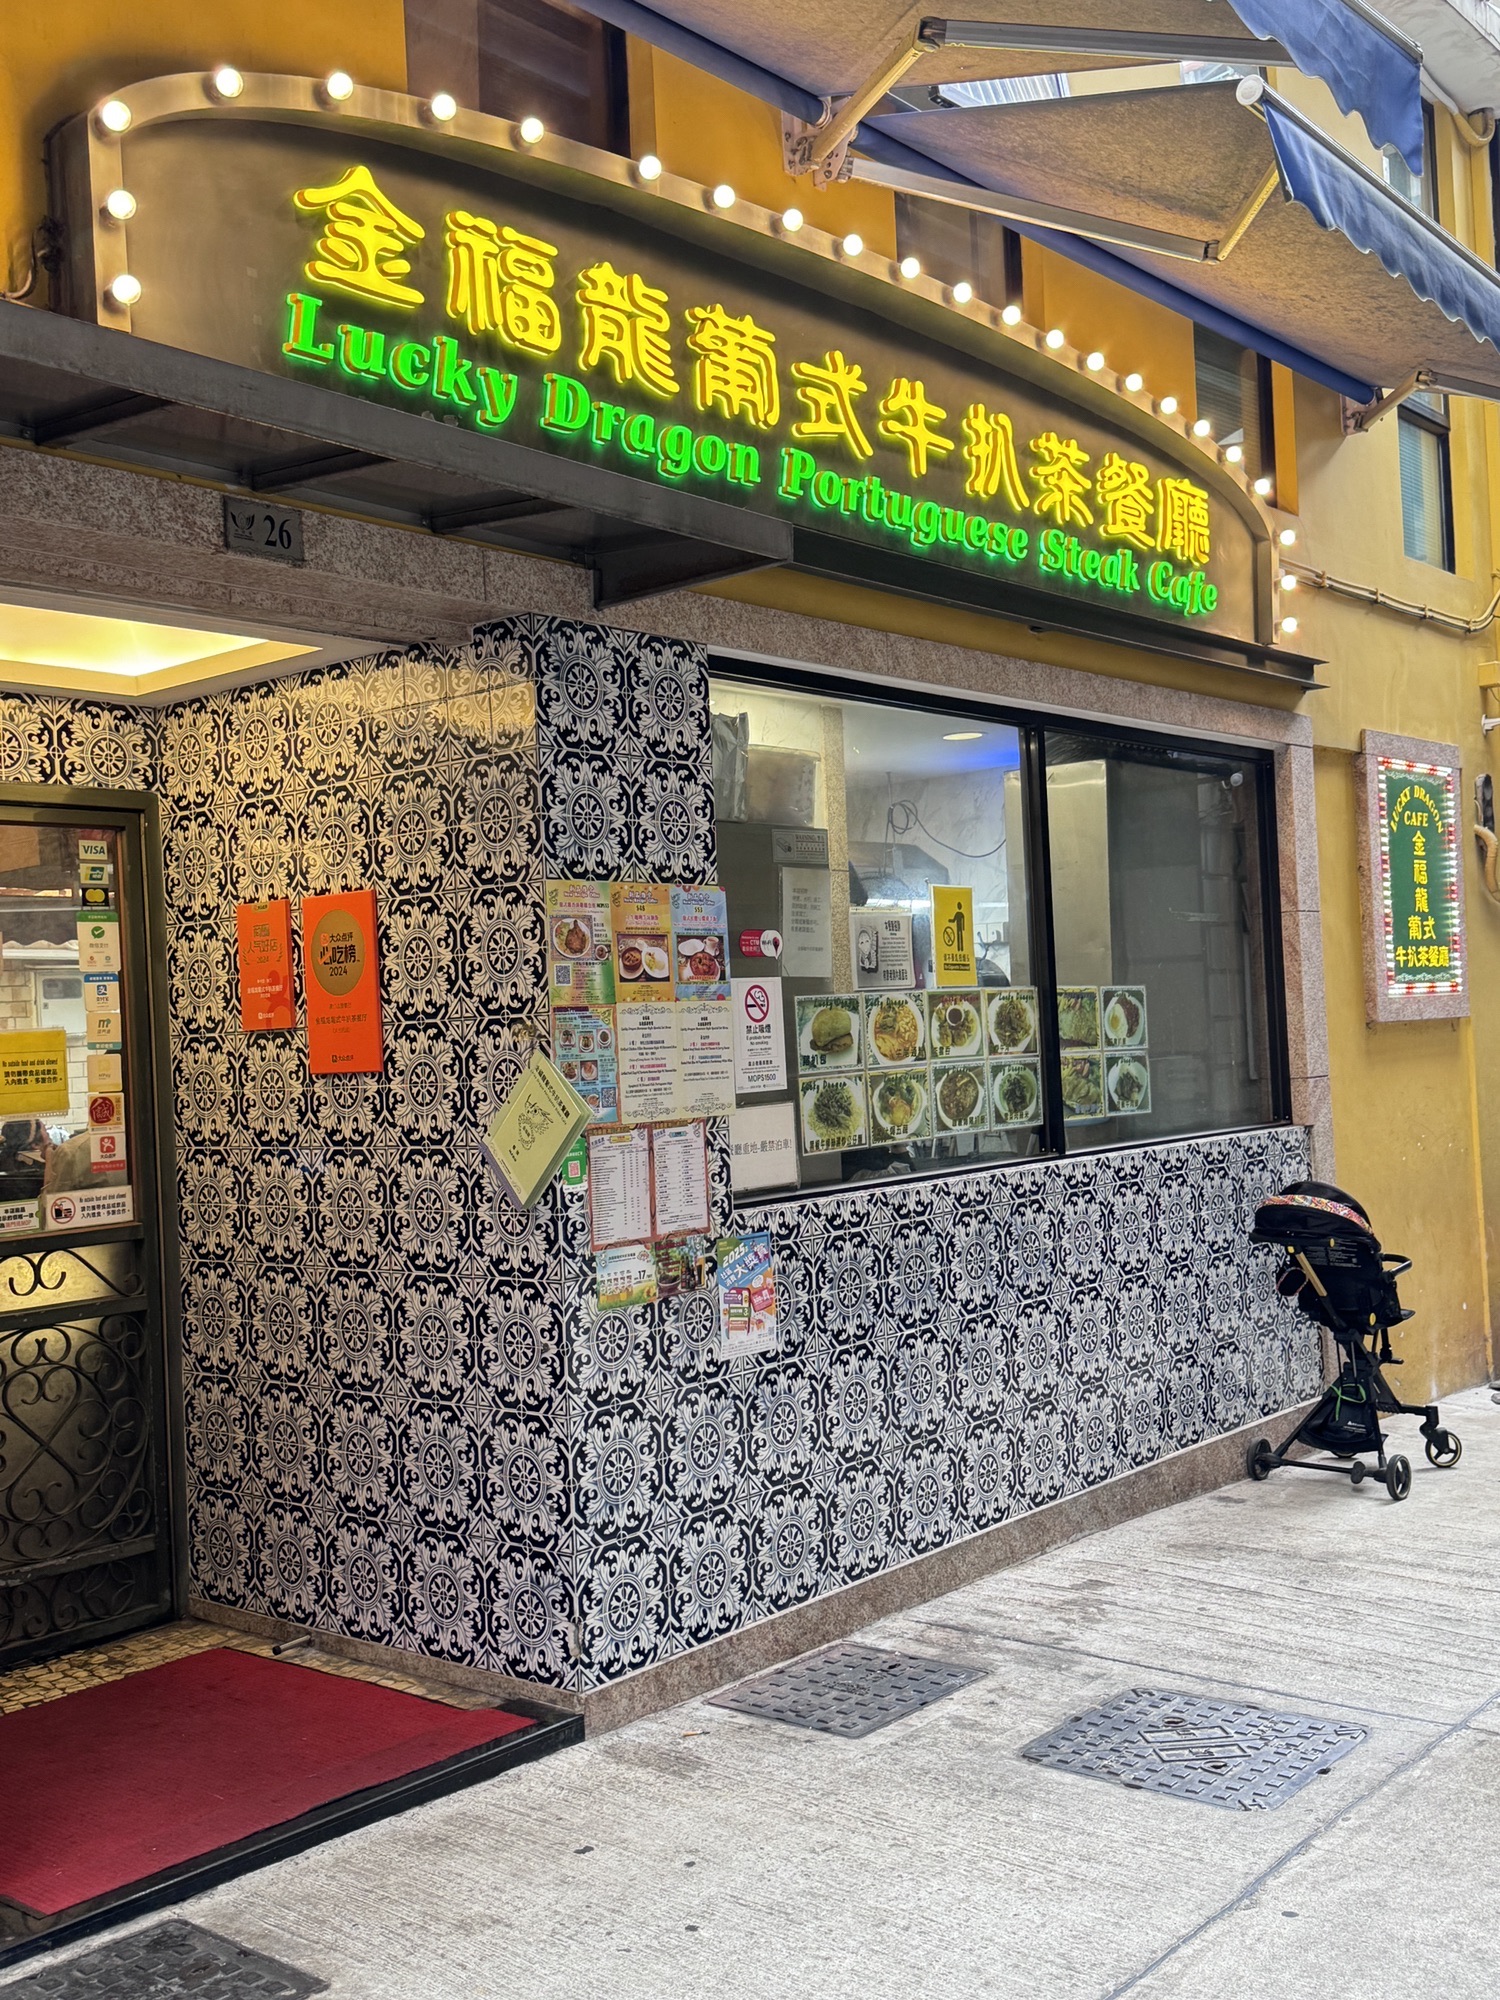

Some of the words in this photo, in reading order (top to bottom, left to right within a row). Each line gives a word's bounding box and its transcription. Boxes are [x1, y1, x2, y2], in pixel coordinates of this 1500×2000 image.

[293, 164, 1211, 566] 金福龍葡式牛扒茶餐廳
[282, 292, 518, 428] Lucky
[539, 372, 761, 487] Dragon
[778, 446, 1029, 561] Portuguese
[1038, 528, 1142, 593] Steak
[1146, 561, 1219, 617] Cafe
[263, 514, 292, 549] 26
[1390, 786, 1411, 833] LUCKY
[1413, 785, 1444, 834] DRAGON
[1404, 810, 1429, 827] CAFE
[81, 844, 106, 855] VISA
[1411, 830, 1430, 913] 金福龍
[329, 931, 353, 943] 大众点评
[1408, 914, 1437, 941] 葡式
[318, 944, 356, 966] 必吃榜
[1395, 944, 1450, 969] 牛扒茶餐廳
[329, 966, 348, 977] 2024
[746, 1023, 771, 1034] 禁止吸煙
[733, 1243, 770, 1279] 大獎賞
[638, 1269, 647, 1280] 17
